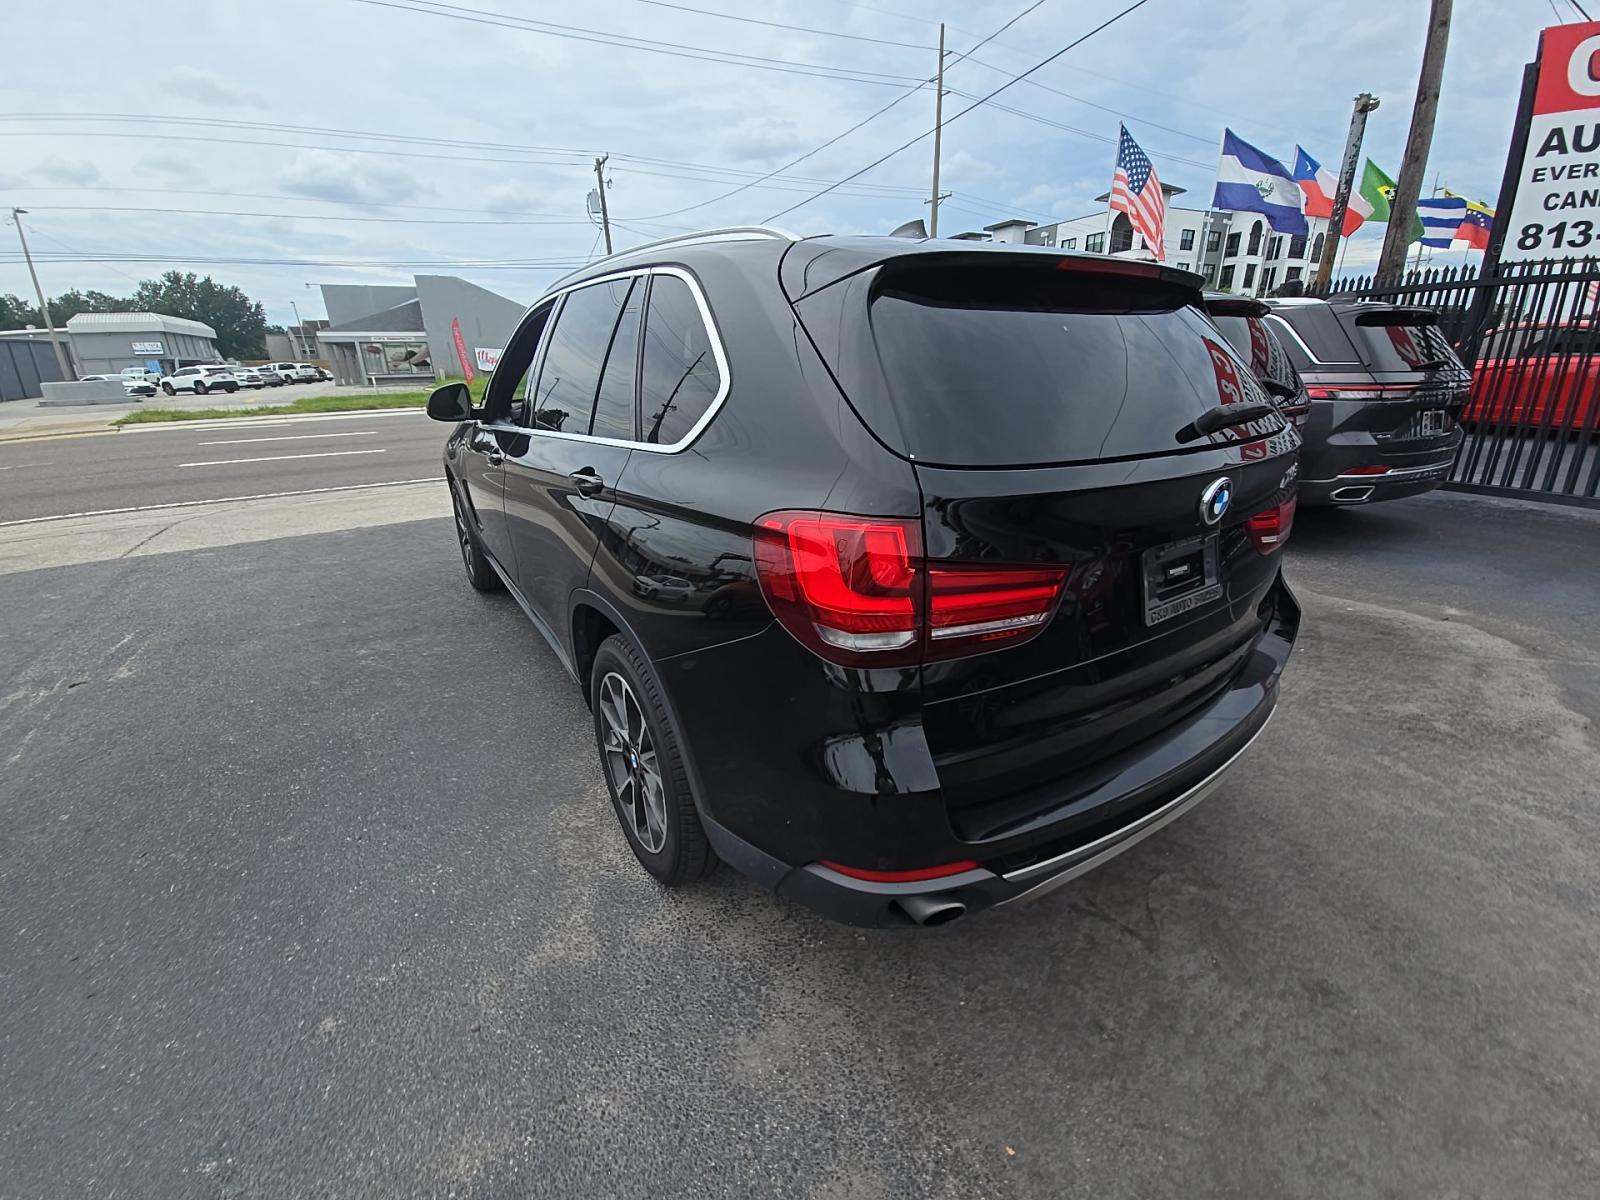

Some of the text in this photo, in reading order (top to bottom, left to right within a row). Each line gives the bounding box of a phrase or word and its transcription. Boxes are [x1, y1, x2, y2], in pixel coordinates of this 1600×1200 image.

[1535, 123, 1600, 158] AU
[1531, 163, 1599, 183] EVER
[1543, 189, 1600, 211] CAN
